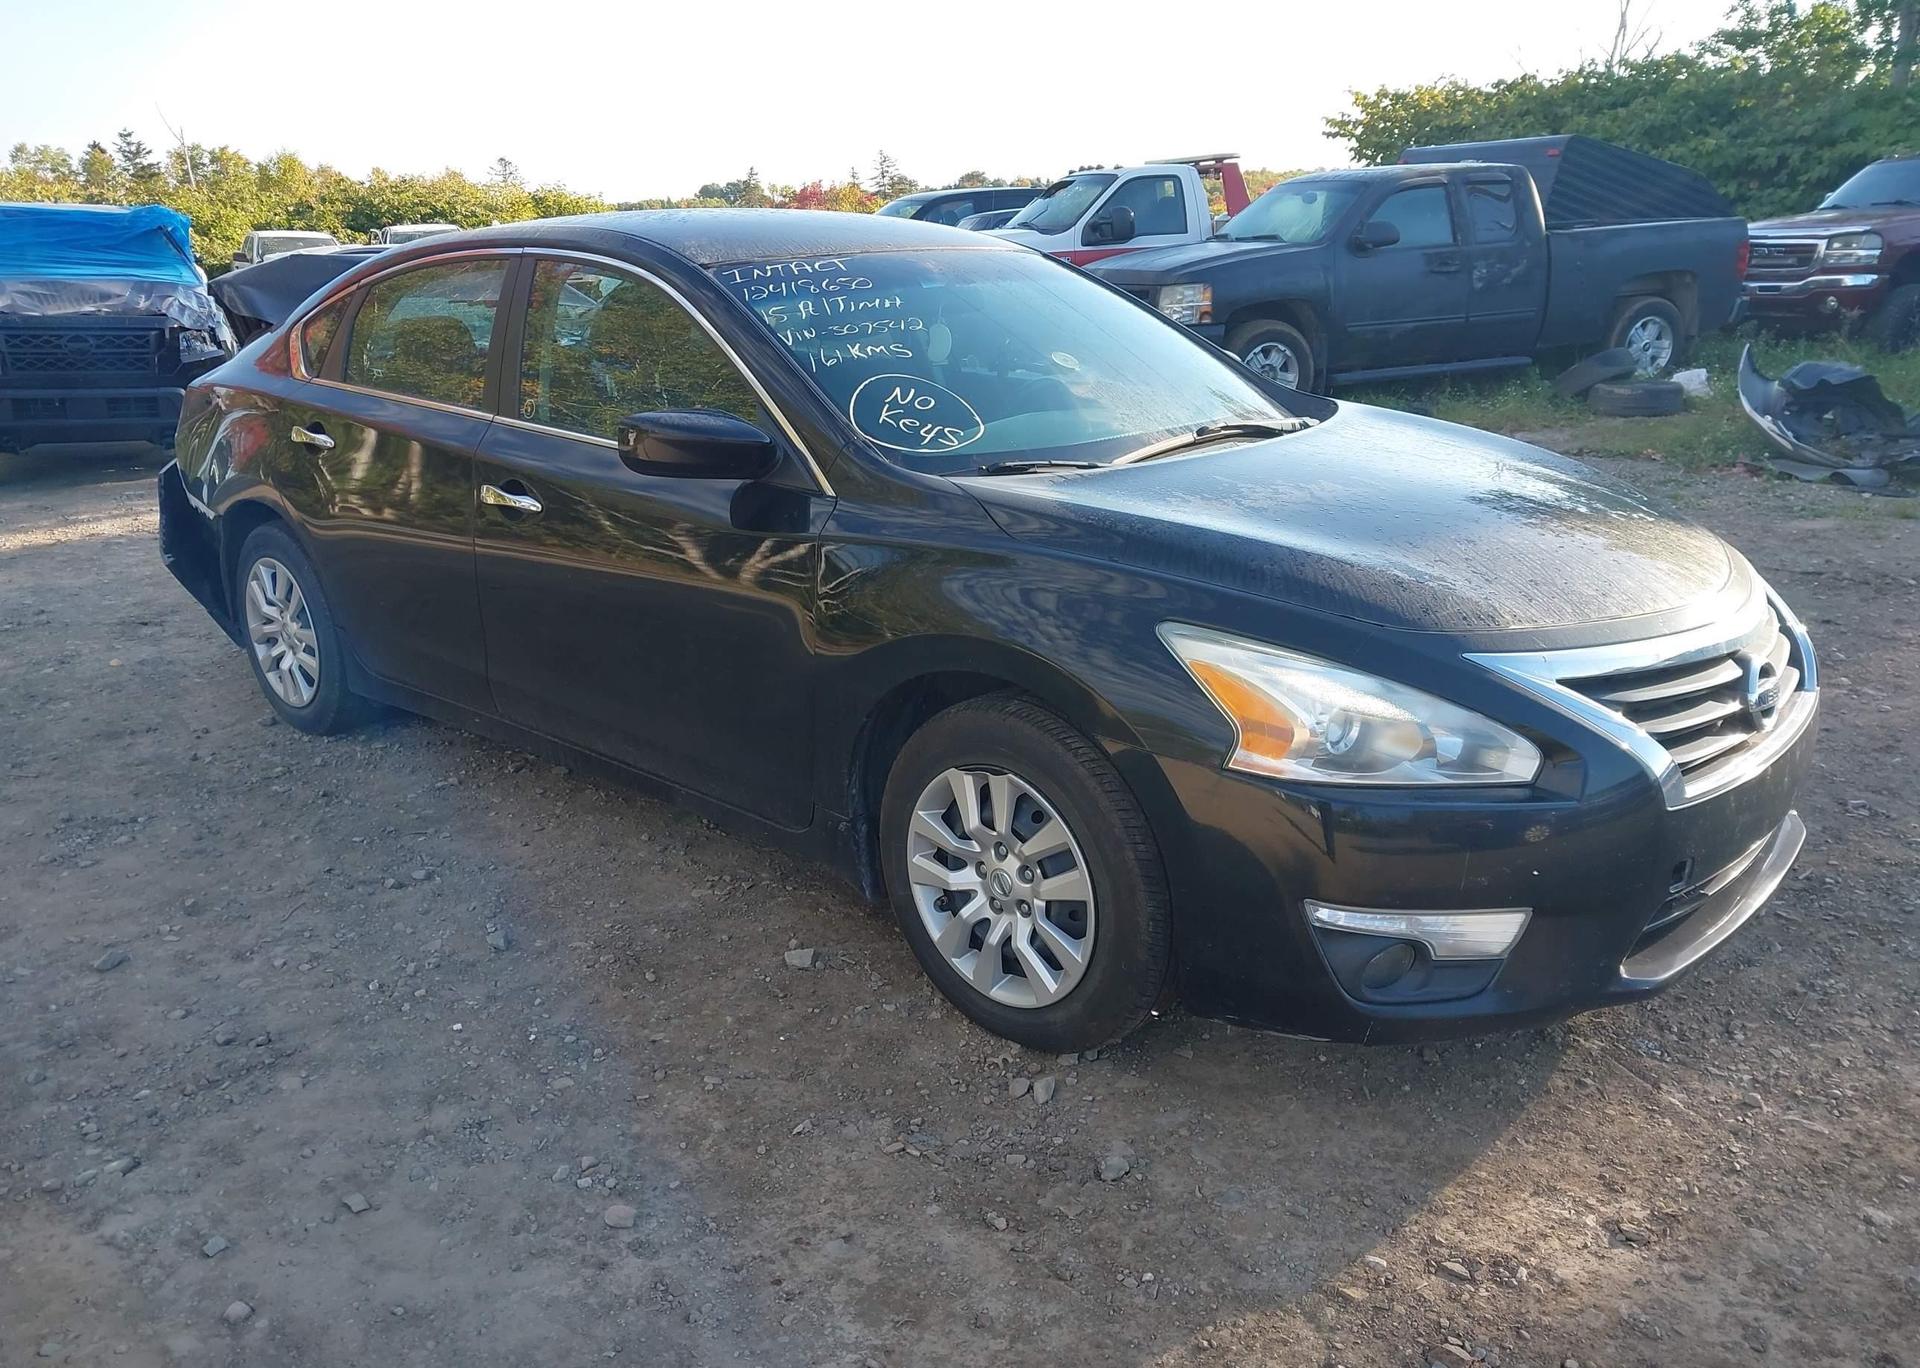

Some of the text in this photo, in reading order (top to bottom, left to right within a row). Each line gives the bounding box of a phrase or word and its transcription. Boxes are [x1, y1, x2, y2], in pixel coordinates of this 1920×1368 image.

[722, 257, 851, 284] INTACT
[743, 277, 873, 302] 12418650
[761, 305, 788, 325] 15
[884, 386, 935, 410] NO
